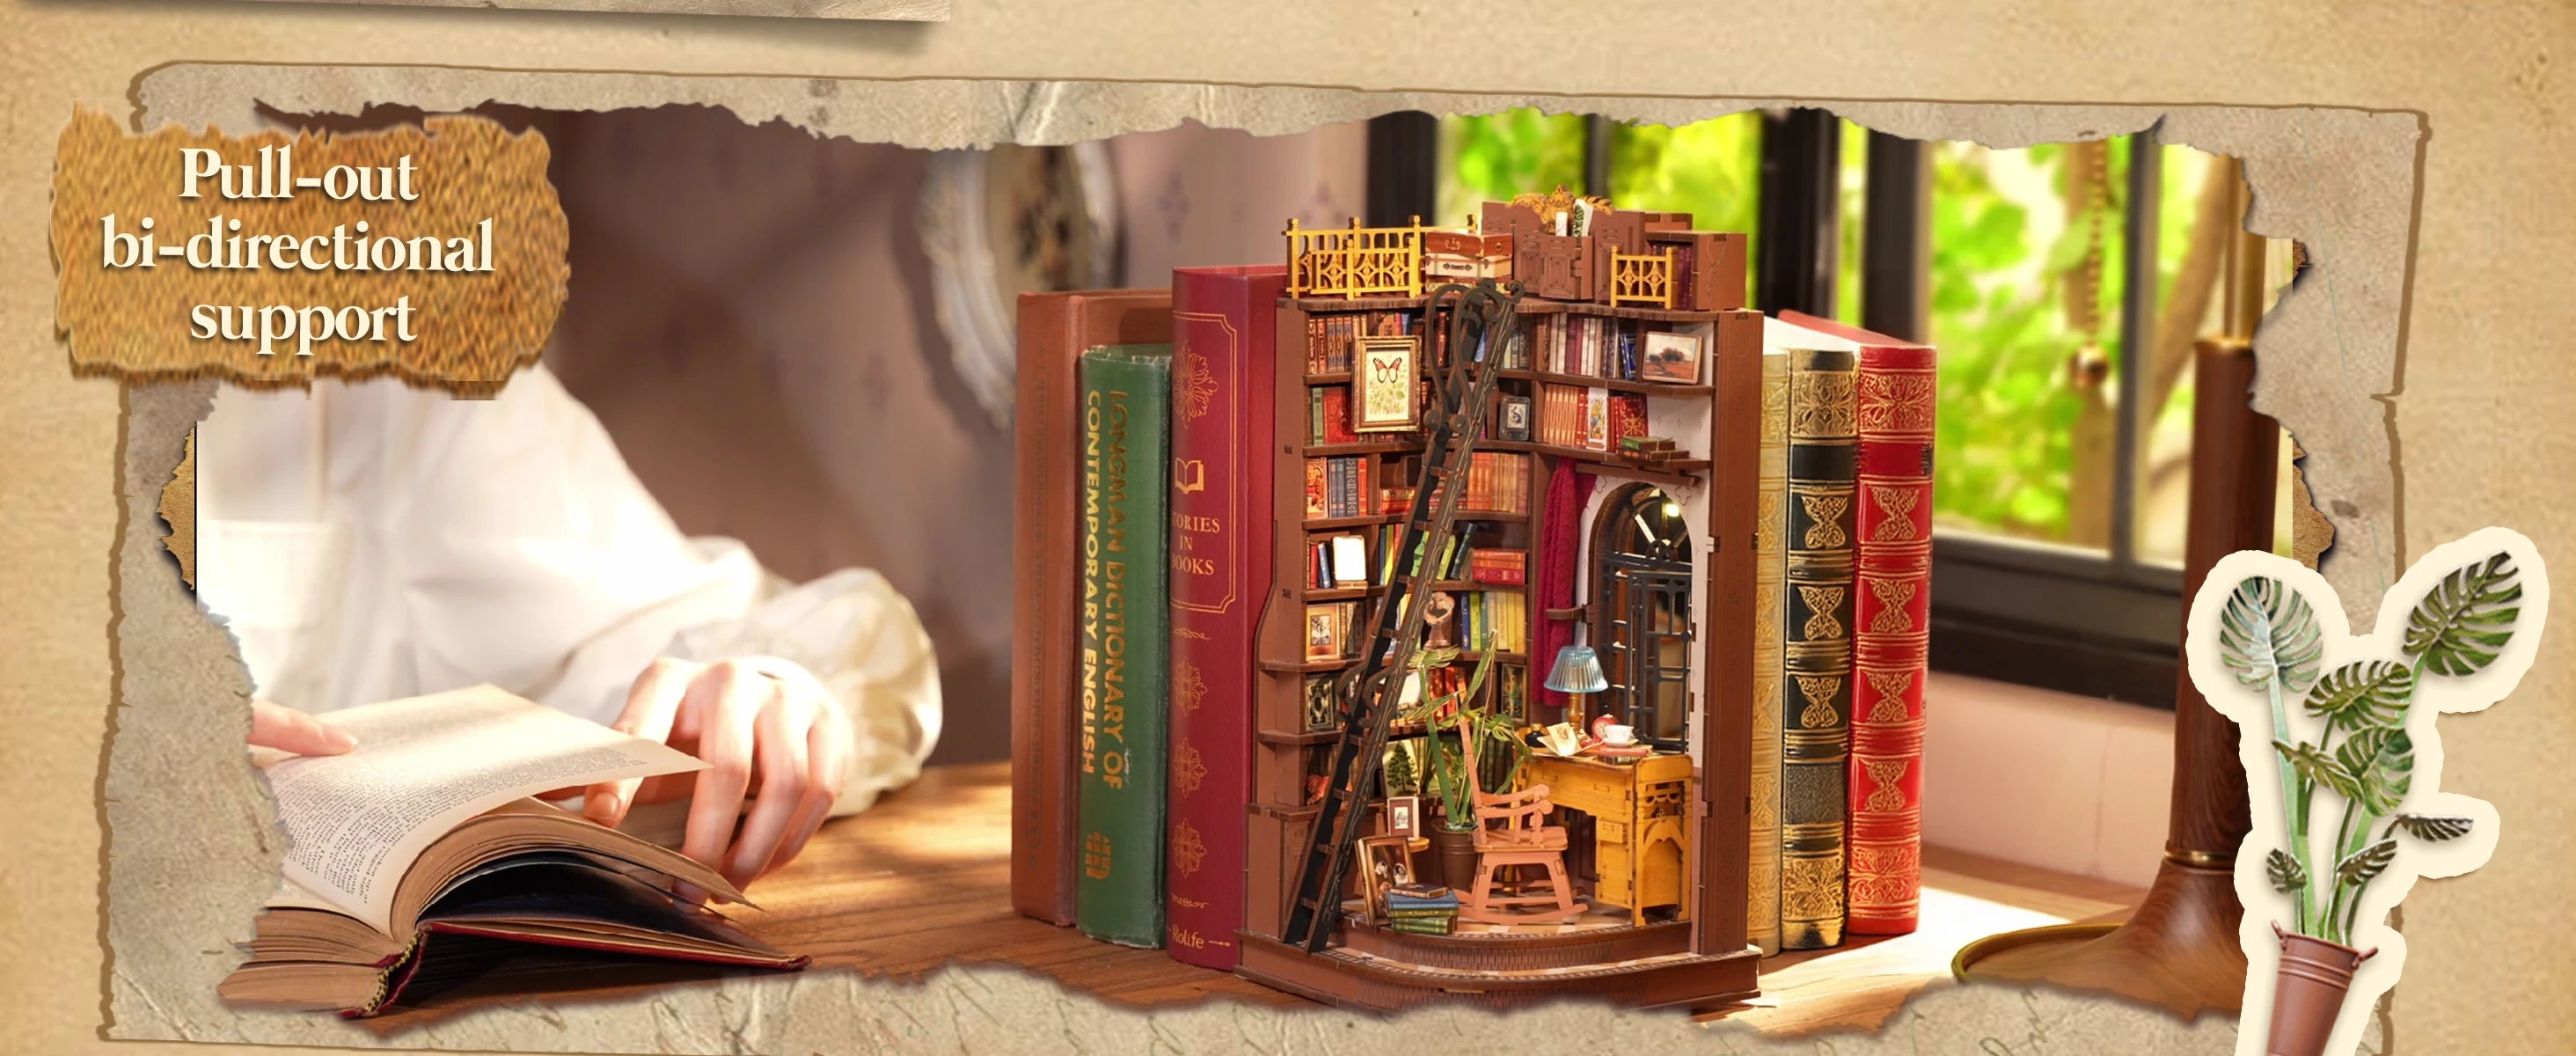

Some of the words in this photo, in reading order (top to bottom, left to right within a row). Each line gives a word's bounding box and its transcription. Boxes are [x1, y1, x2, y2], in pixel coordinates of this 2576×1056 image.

[1085, 390, 1101, 640] CONTEMPORARY
[1107, 391, 1128, 552] LONGMAN
[1179, 535, 1193, 551] IN
[1082, 649, 1097, 774] ENGLISH
[1104, 561, 1125, 743] DICTIONARY
[1102, 751, 1123, 788] OF
[1172, 924, 1204, 950] Rolife
